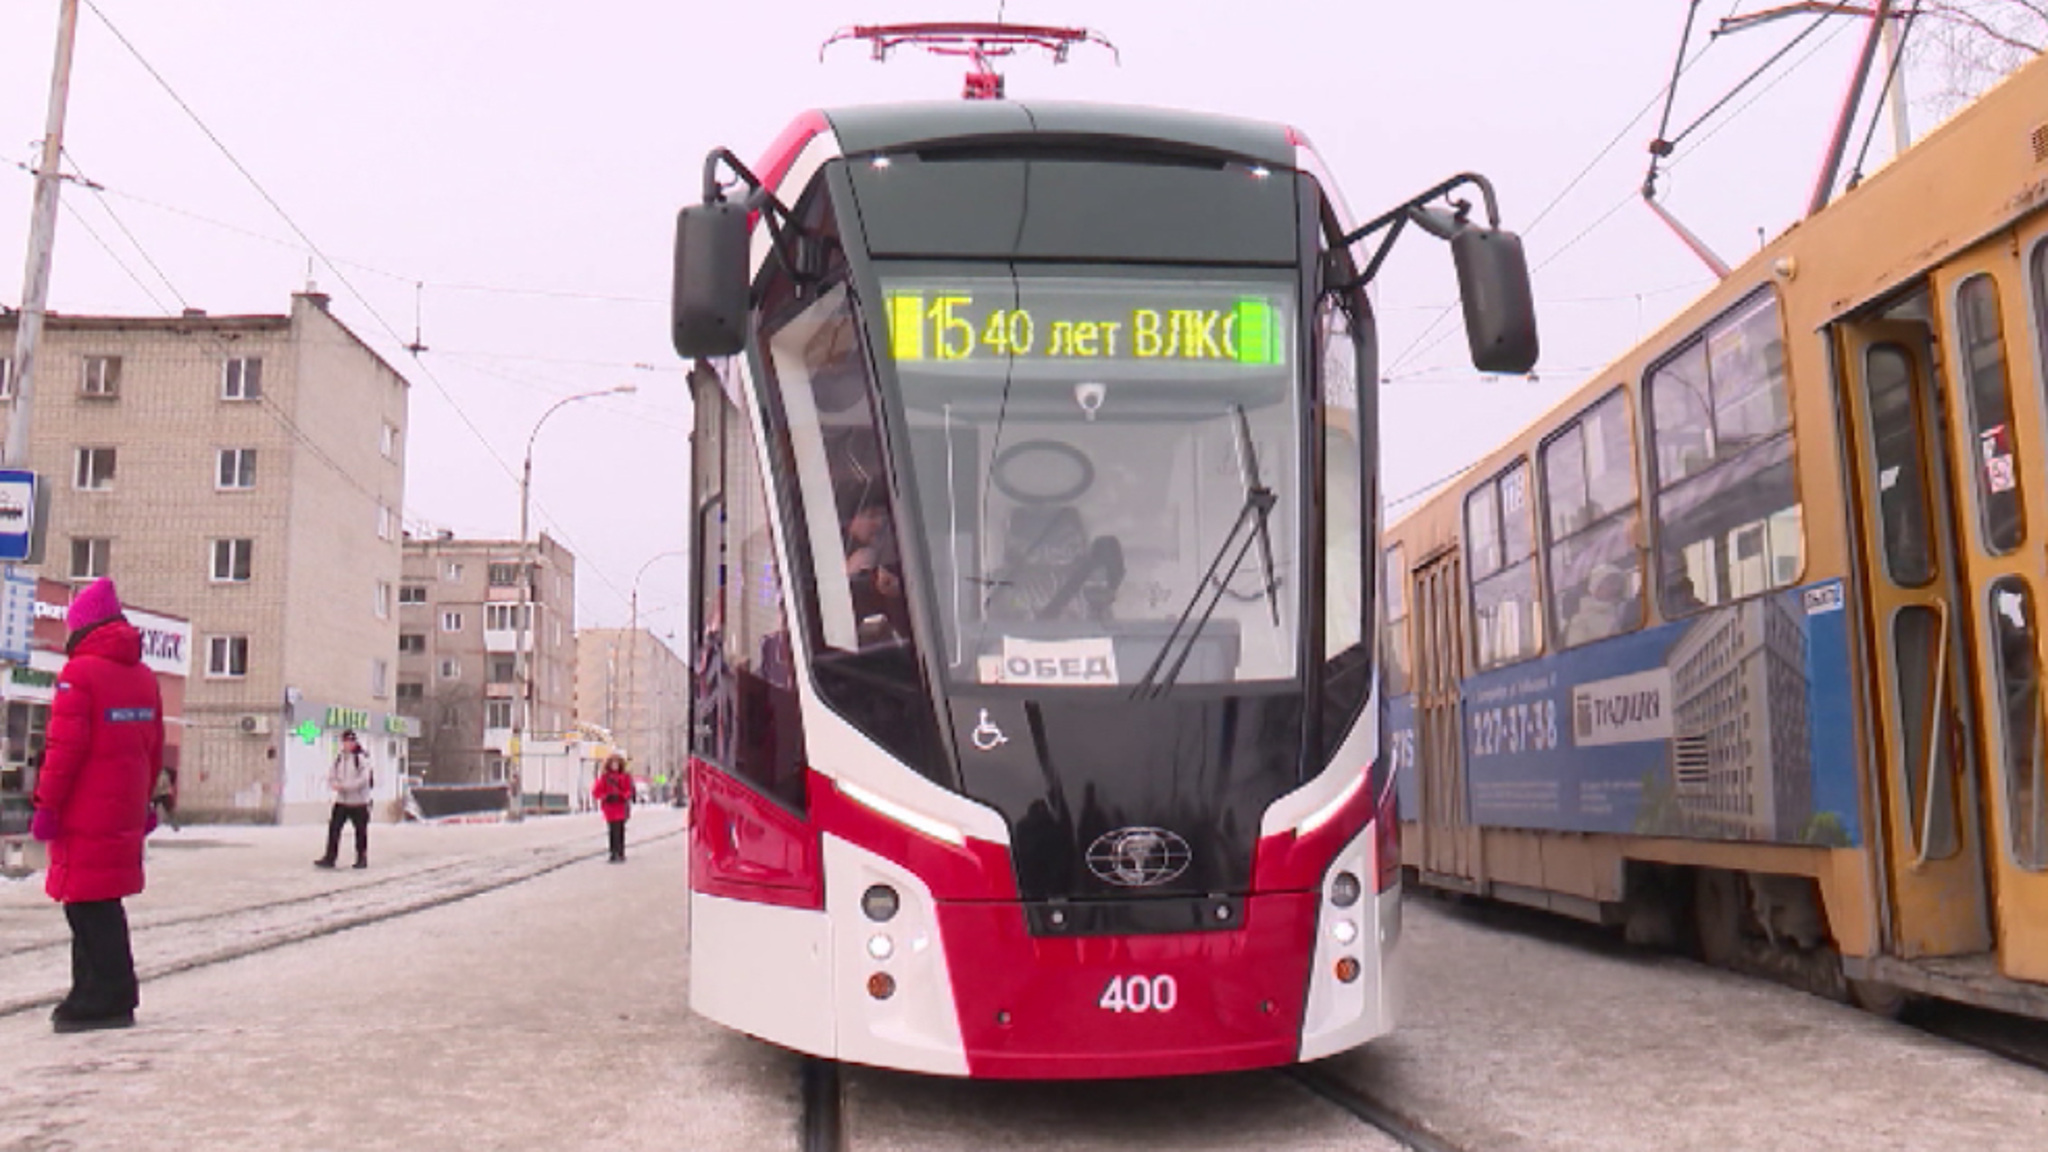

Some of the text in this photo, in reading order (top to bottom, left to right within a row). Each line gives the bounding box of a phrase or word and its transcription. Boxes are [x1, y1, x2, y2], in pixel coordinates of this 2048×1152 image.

[927, 295, 976, 360] 15
[983, 309, 1034, 356] 40
[1047, 320, 1121, 356] лет
[1007, 656, 1111, 680] ОБЕД
[1099, 974, 1178, 1013] 400
